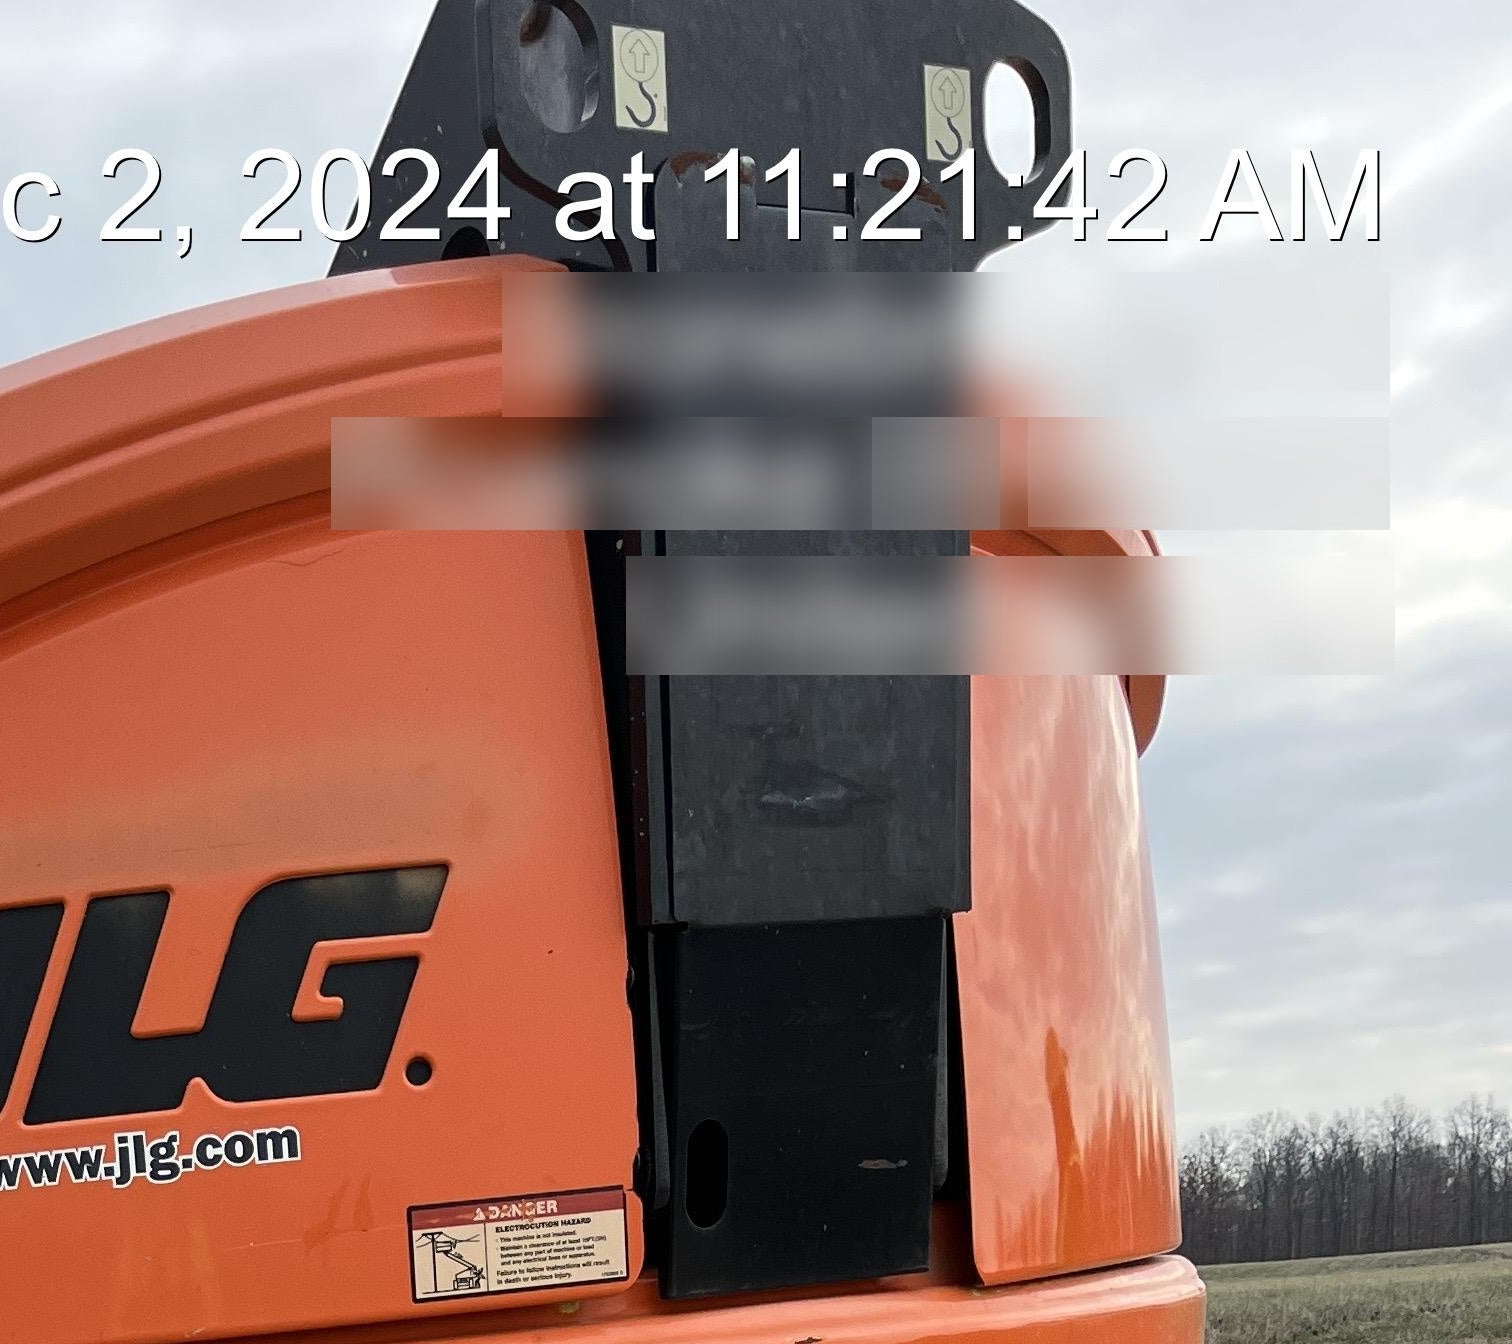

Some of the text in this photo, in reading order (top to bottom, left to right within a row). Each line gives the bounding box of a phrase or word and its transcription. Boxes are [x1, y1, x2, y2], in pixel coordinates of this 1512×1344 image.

[488, 1200, 558, 1220] DANGER
[495, 1217, 591, 1233] ELECTROCUTION HAZARD
